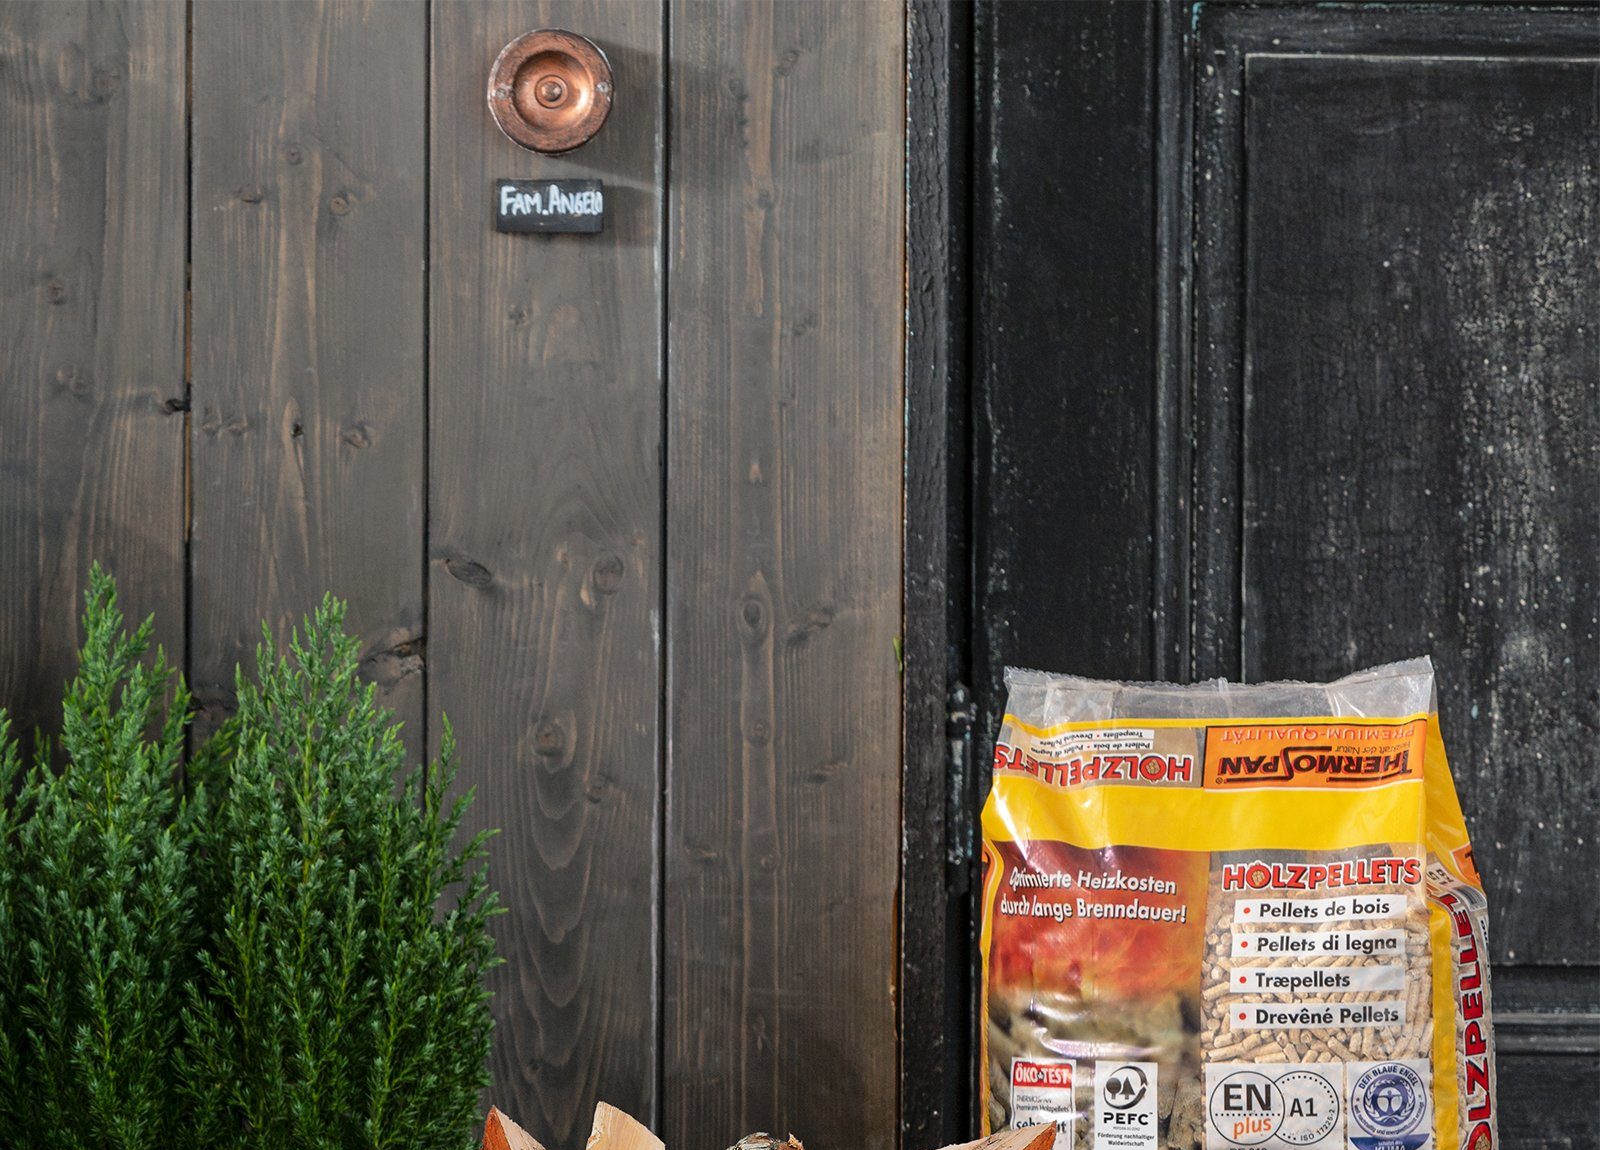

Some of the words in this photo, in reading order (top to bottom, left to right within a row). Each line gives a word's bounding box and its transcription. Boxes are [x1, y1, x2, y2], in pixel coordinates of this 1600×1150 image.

[1125, 742, 1150, 750] Pellets
[1335, 745, 1360, 753] Natur
[993, 743, 1193, 787] HOLZPELLETS
[1220, 746, 1412, 783] THERMOSPAN
[1009, 866, 1072, 891] Optimierte
[1077, 870, 1177, 894] Heizkosten
[1223, 859, 1421, 890] HOLZPELLETS
[1000, 893, 1030, 916] durch
[1032, 895, 1073, 922] lange
[1076, 898, 1187, 923] Brenndauer!
[1260, 902, 1318, 918] Pellets
[1325, 901, 1346, 916] de
[1352, 898, 1390, 914] bois
[1257, 936, 1315, 952] Pellets
[1322, 935, 1339, 950] di
[1346, 934, 1397, 954] legna
[1255, 971, 1351, 992] Træpellets
[1340, 1006, 1399, 1023] Pellets
[1358, 1074, 1372, 1090] DER
[1372, 1065, 1398, 1077] BLAUE
[1399, 1067, 1419, 1087] ENGEL
[1224, 1084, 1271, 1111] EN
[1289, 1098, 1318, 1117] A1
[1103, 1112, 1149, 1126] PEFC
[1234, 1117, 1272, 1139] plus
[1300, 1133, 1315, 1141] ISO
[1316, 1108, 1336, 1136] 17225-2
